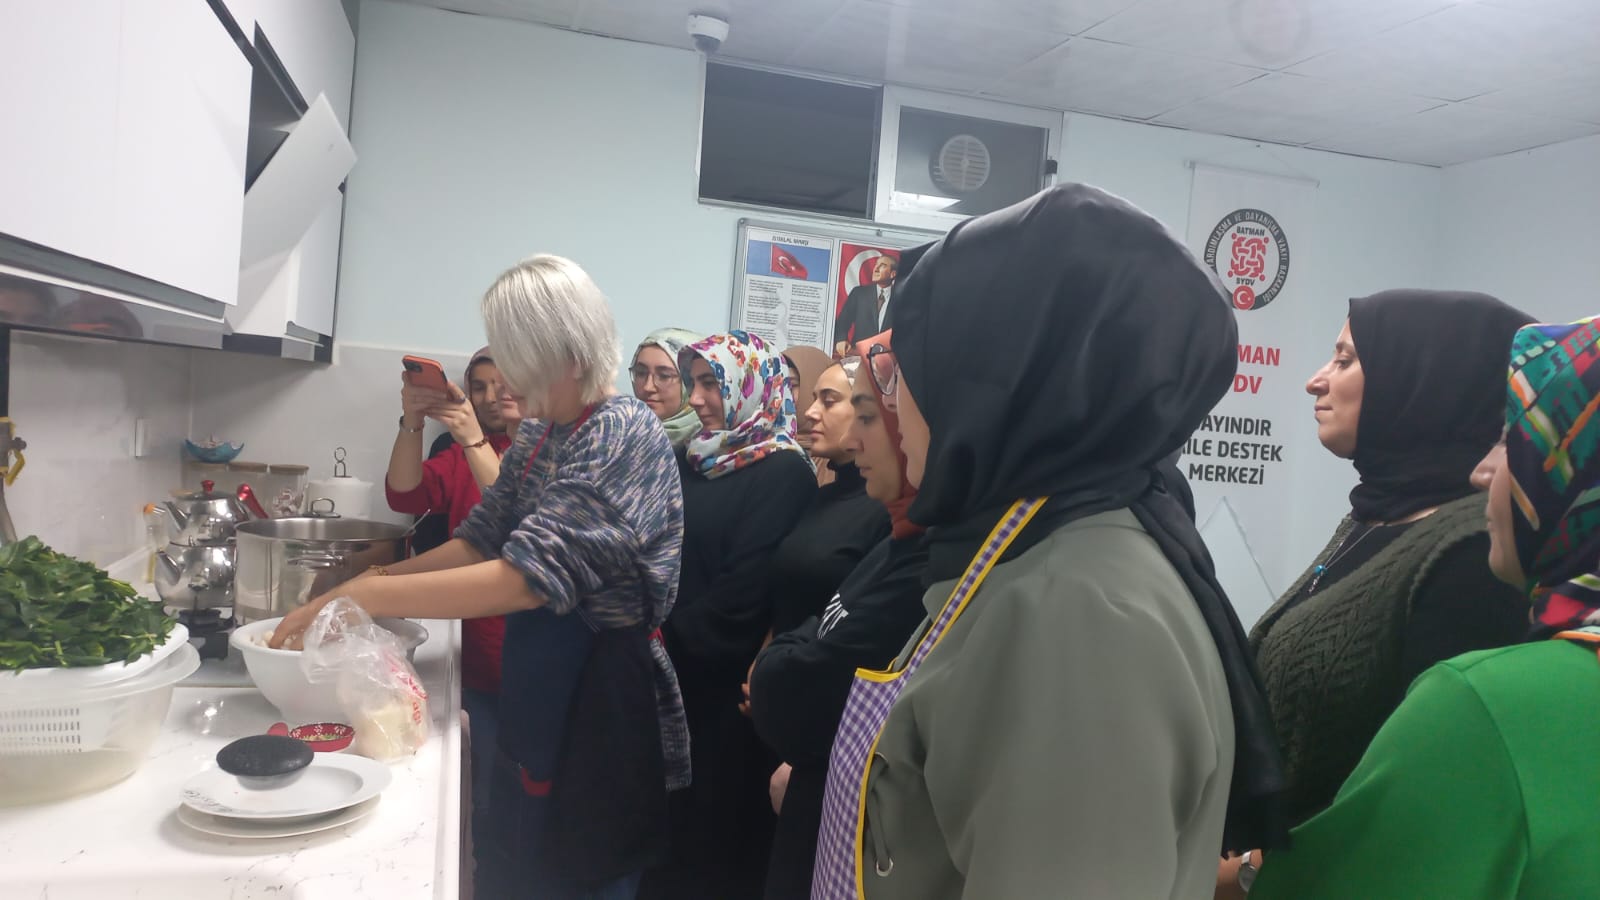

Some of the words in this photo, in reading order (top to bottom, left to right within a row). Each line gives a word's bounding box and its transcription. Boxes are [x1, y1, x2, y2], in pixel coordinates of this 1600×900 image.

[1236, 226, 1265, 236] BATMAN
[1237, 344, 1280, 366] MAN
[1234, 374, 1262, 394] DV
[1200, 415, 1272, 437] AYINDIR
[1217, 440, 1283, 462] DESTEK
[1189, 463, 1265, 485] MERKEZİ
